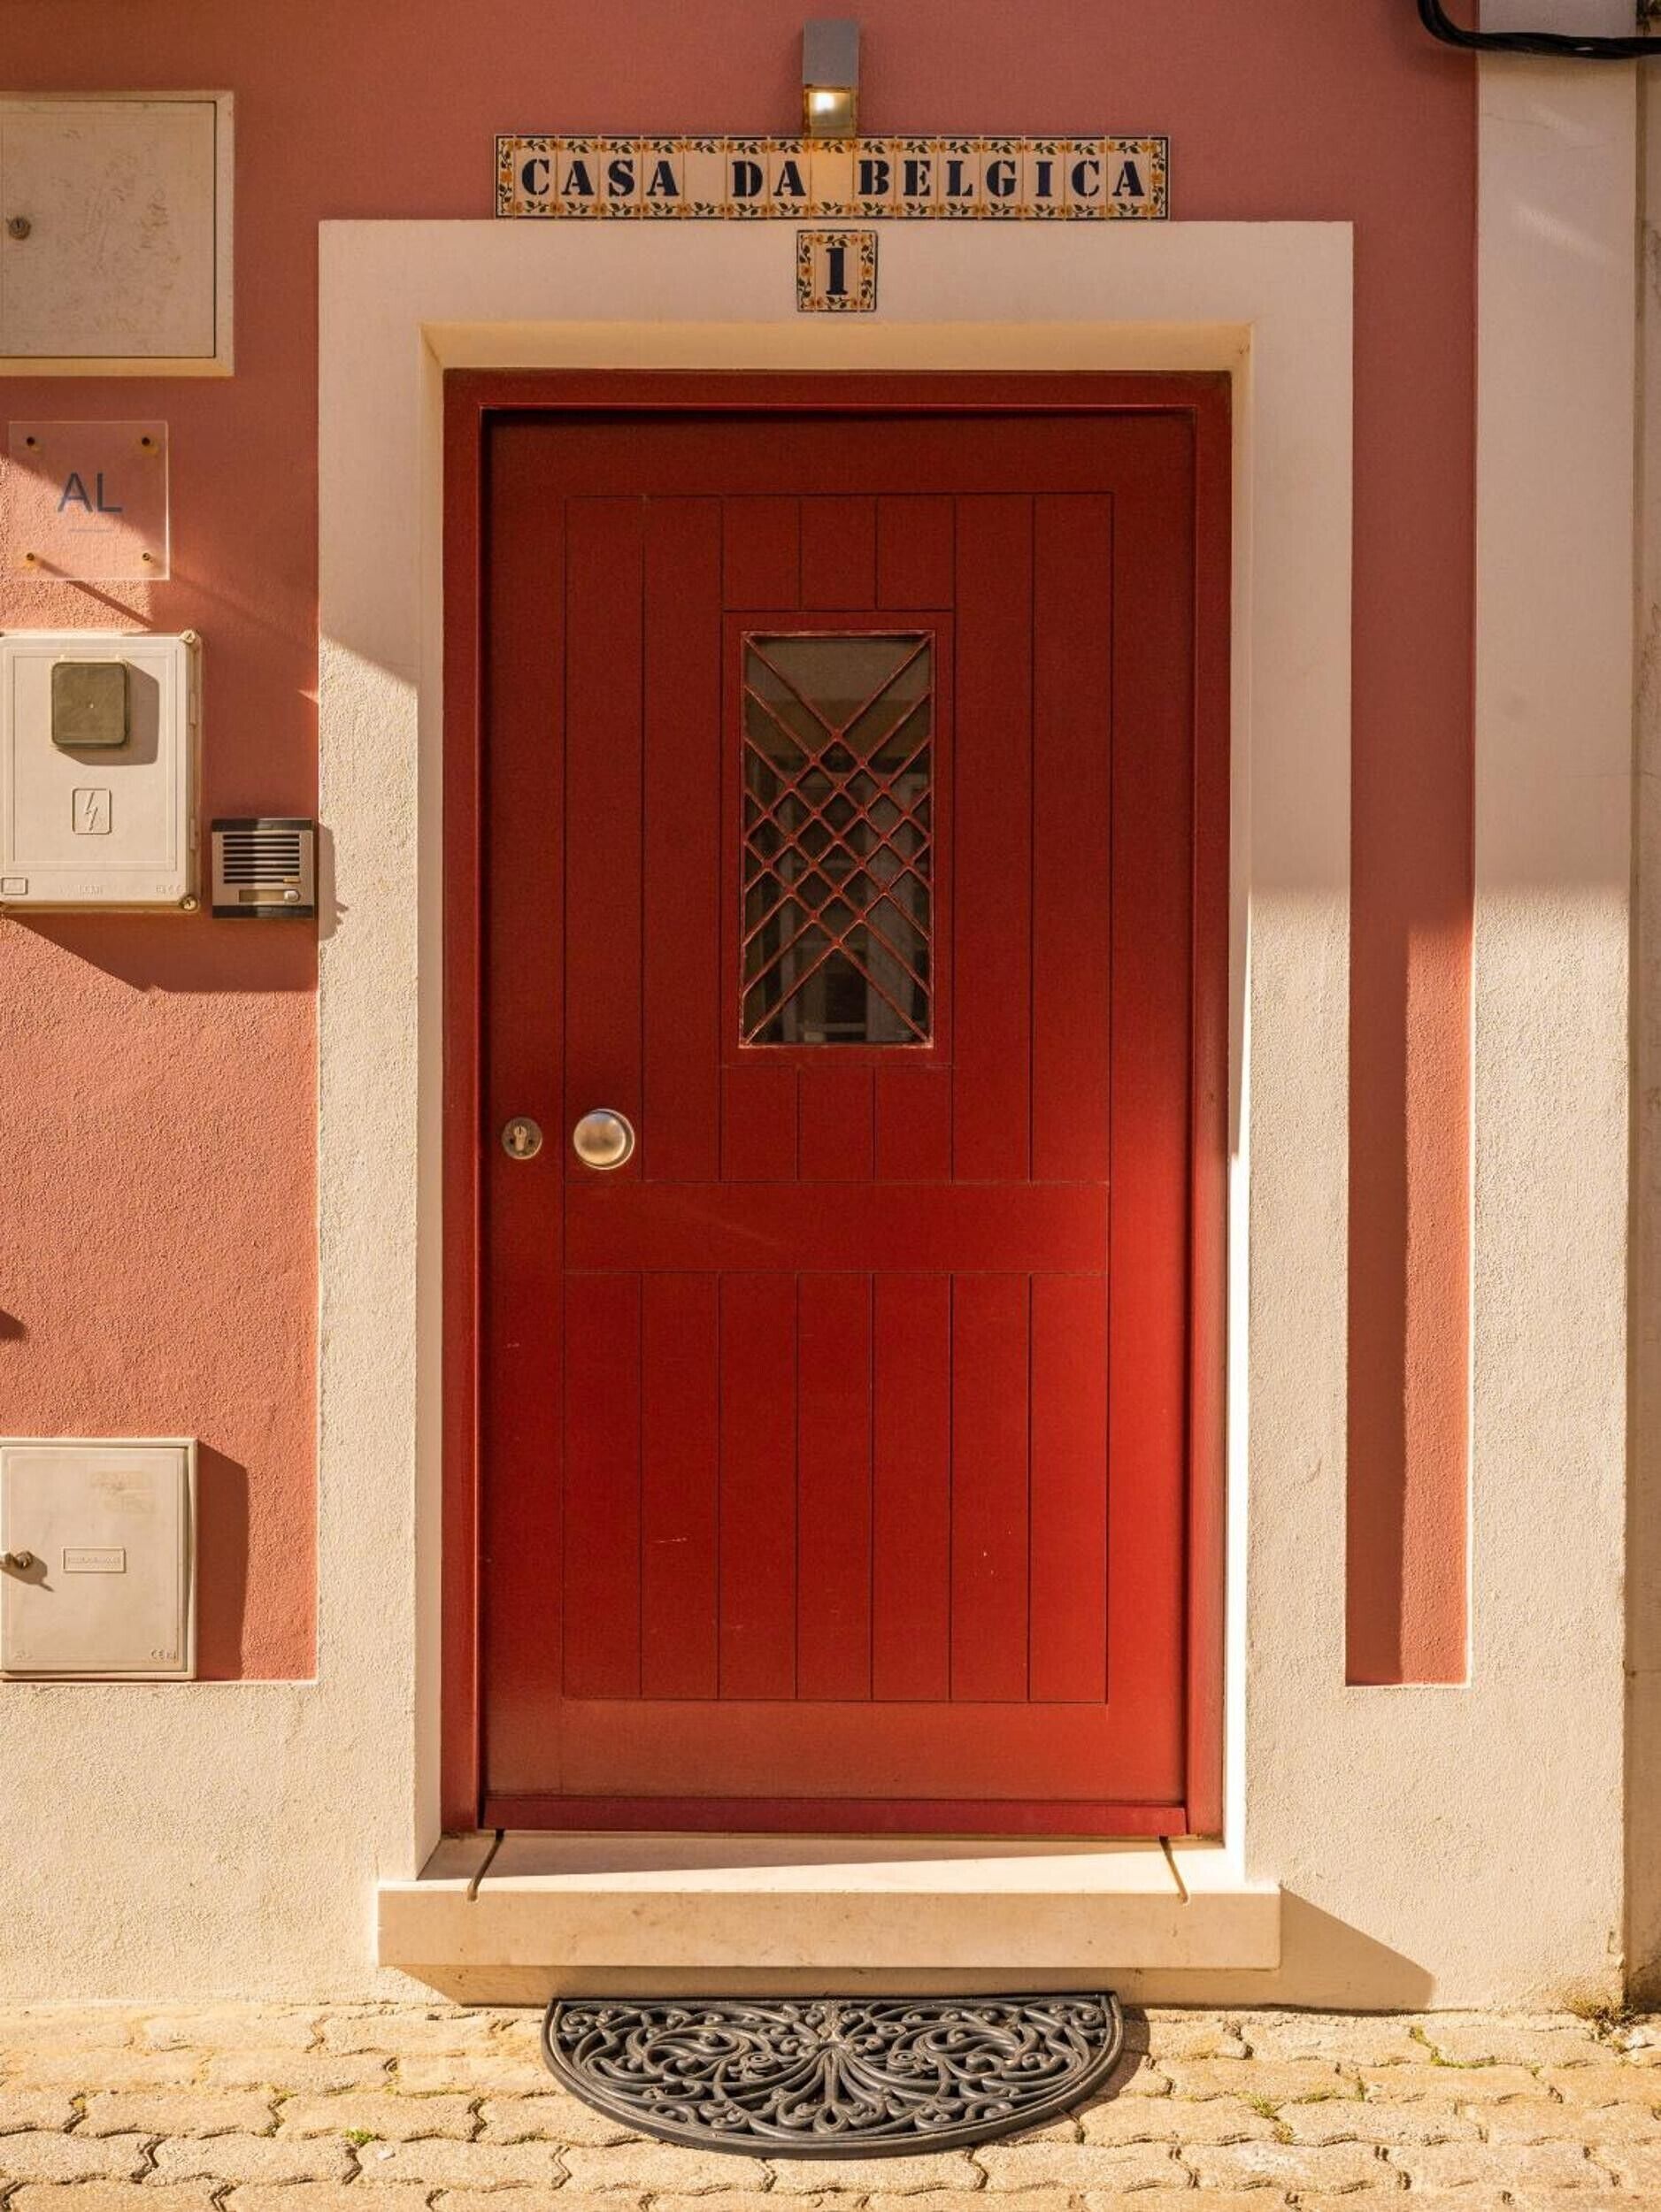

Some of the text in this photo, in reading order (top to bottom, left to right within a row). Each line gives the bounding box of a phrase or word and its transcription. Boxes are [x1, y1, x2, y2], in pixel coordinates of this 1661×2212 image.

[520, 158, 1145, 197] CASA DA BELGICA
[825, 247, 848, 296] 1
[58, 472, 123, 513] AL
